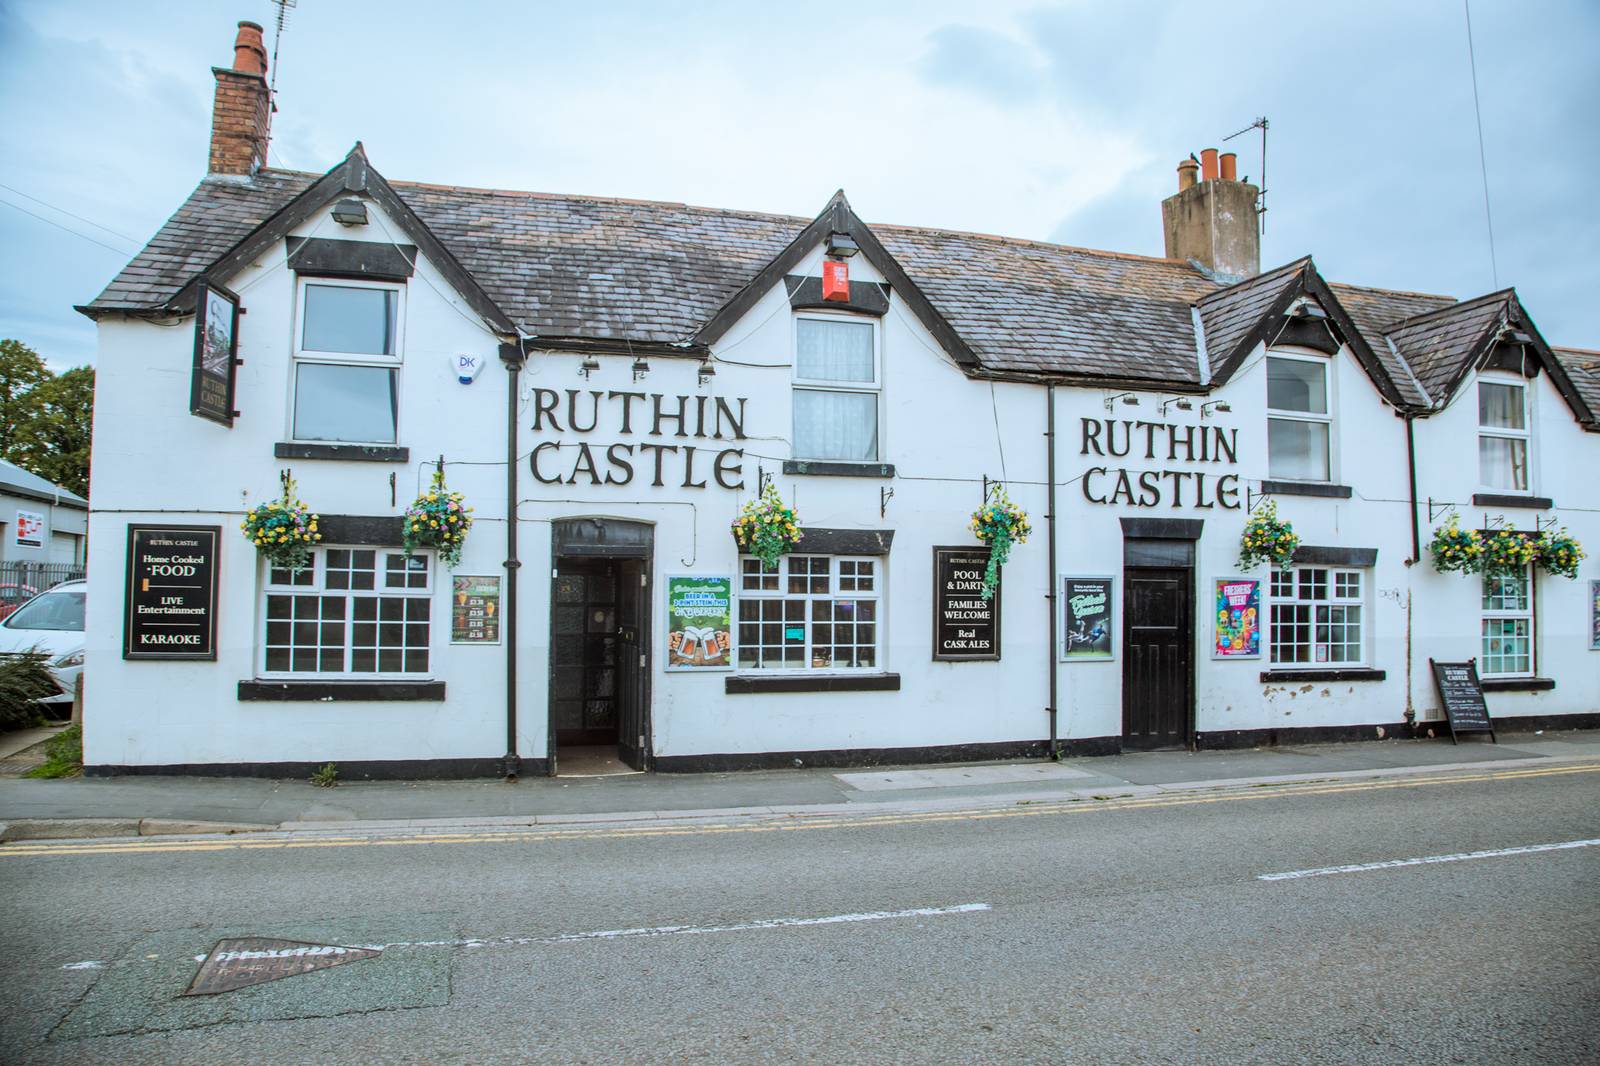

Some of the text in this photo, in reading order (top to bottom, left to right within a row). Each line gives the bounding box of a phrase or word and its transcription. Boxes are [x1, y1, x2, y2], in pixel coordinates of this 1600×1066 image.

[201, 390, 226, 408] CASTLE
[531, 388, 748, 440] RUTHIN
[1080, 417, 1239, 464] RUTHIN
[530, 440, 745, 490] CASTLE
[1082, 466, 1241, 509] CASTLE
[143, 555, 204, 564] Home Cooked
[151, 565, 196, 576] FOOD
[954, 570, 982, 580] POOL
[947, 582, 954, 590] &
[161, 596, 184, 605] LIVE
[948, 600, 987, 609] FAMILIES
[138, 605, 206, 614] Entertainment
[944, 611, 991, 619] WELCOME
[958, 629, 976, 638] Real
[141, 634, 201, 644] KARAOKE
[944, 640, 990, 649] CASK ALES
